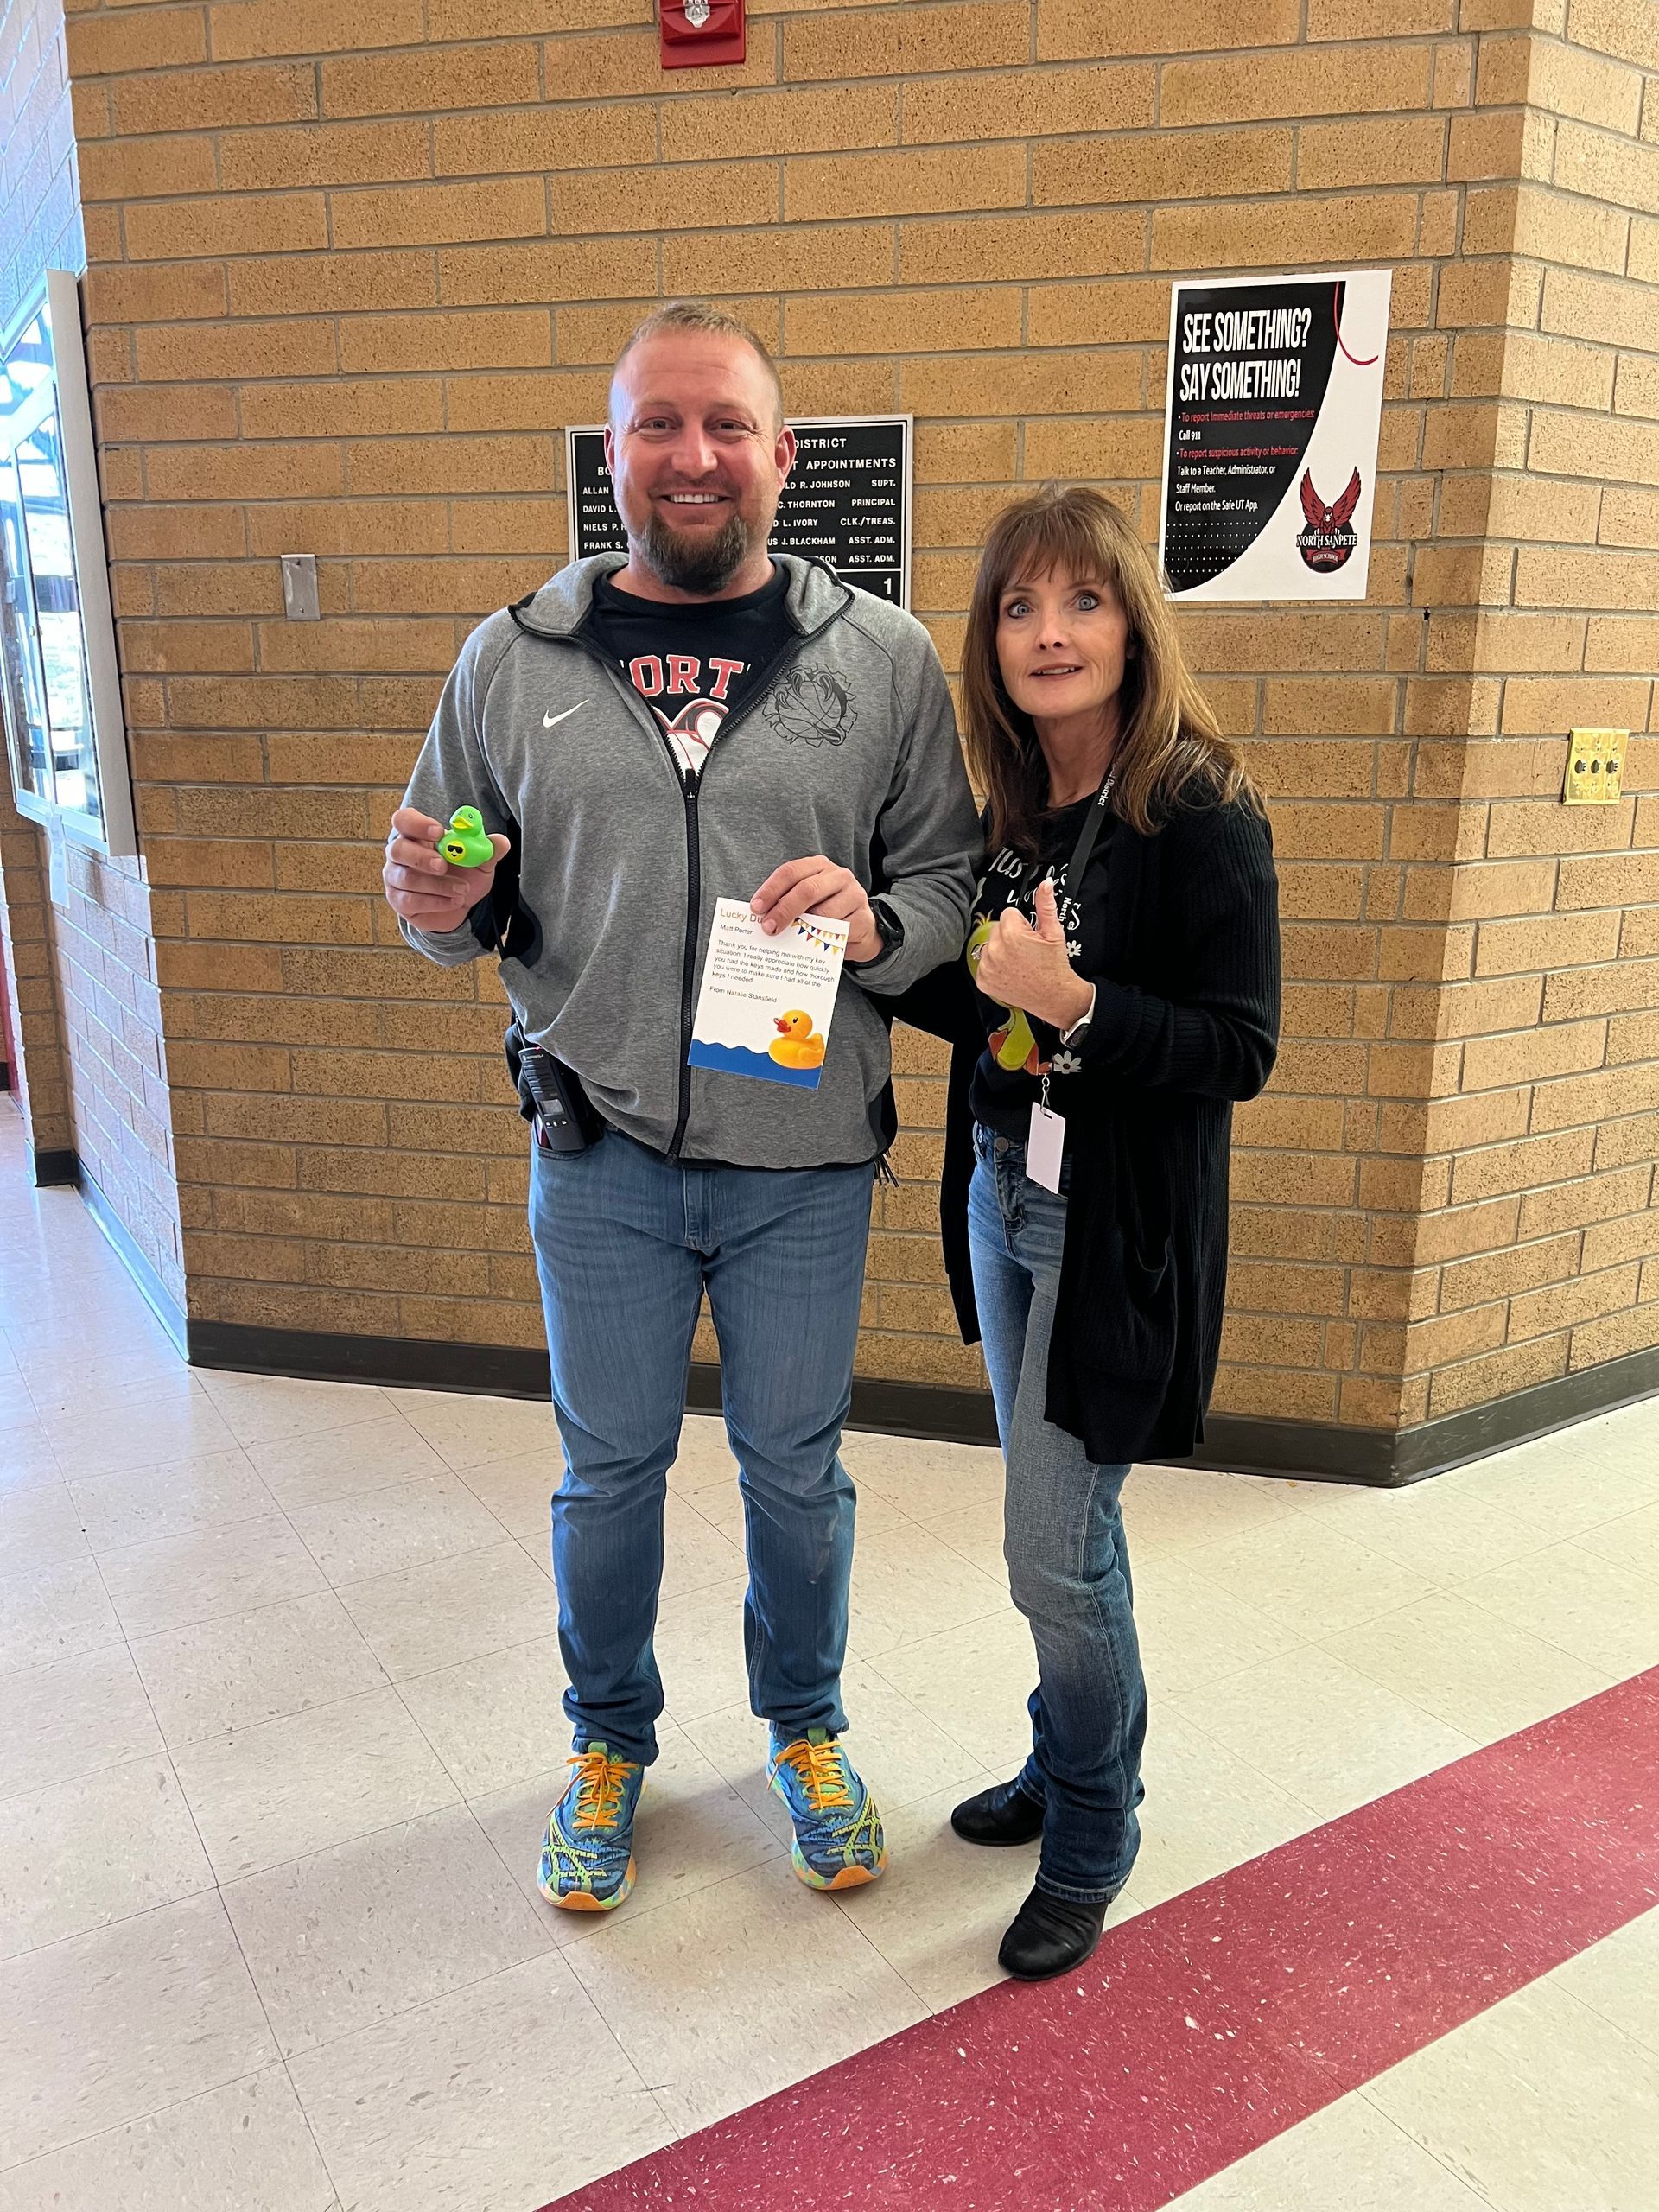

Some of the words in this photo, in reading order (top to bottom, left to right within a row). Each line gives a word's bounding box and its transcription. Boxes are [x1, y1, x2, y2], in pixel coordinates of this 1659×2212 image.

[1183, 313, 1212, 353] SEE
[1213, 308, 1312, 353] SOMETHING?
[1179, 363, 1211, 402] SAY
[1211, 359, 1301, 400] SOMETHING!
[1181, 412, 1190, 423] To
[1191, 413, 1210, 424] report
[1244, 410, 1266, 421] threats
[1179, 430, 1190, 441] Call
[1191, 431, 1201, 441] 911
[1179, 448, 1188, 458] To
[1189, 448, 1207, 461] report
[1208, 448, 1239, 459] suspicious
[1240, 447, 1262, 458] activity
[805, 458, 896, 471] APPOINTMENTS
[1177, 466, 1189, 476] Talk
[1191, 467, 1196, 475] to
[1203, 465, 1227, 475] Teacher,
[1228, 464, 1268, 474] Administrator,
[810, 480, 851, 489] JOHNSON
[871, 479, 896, 487] SUPT.
[1176, 483, 1190, 493] Staff
[1191, 483, 1216, 493] Member.
[787, 499, 836, 509] THORNTON
[851, 499, 895, 507] PRINCIPAL
[1175, 501, 1183, 512] Or
[1184, 501, 1201, 512] report
[1211, 500, 1221, 510] the
[1222, 499, 1235, 510] Safe
[1236, 499, 1244, 510] UT
[1245, 499, 1258, 512] App.
[583, 523, 607, 531] NIELS
[793, 518, 818, 527] IVORY
[840, 516, 896, 527] CLK./TREAS.
[584, 541, 612, 550] FRANK
[790, 537, 836, 545] BLACKHAM
[849, 536, 872, 544] ASST.
[1297, 533, 1324, 549] NORTH
[1324, 533, 1357, 549] SANPETE
[849, 555, 872, 563] ASST.
[883, 577, 892, 595] 1
[620, 654, 751, 699] ORT
[720, 908, 747, 923] Lucky
[749, 913, 762, 924] Du
[1058, 896, 1072, 923] North
[734, 926, 753, 935] Porter
[718, 939, 735, 949] Thank
[759, 947, 780, 957] helping
[764, 957, 795, 967] appreciate
[810, 965, 830, 975] quickly
[809, 973, 835, 983] thorough
[709, 985, 726, 994] From
[726, 988, 747, 998] Natalie
[747, 992, 778, 1003] Stansfield
